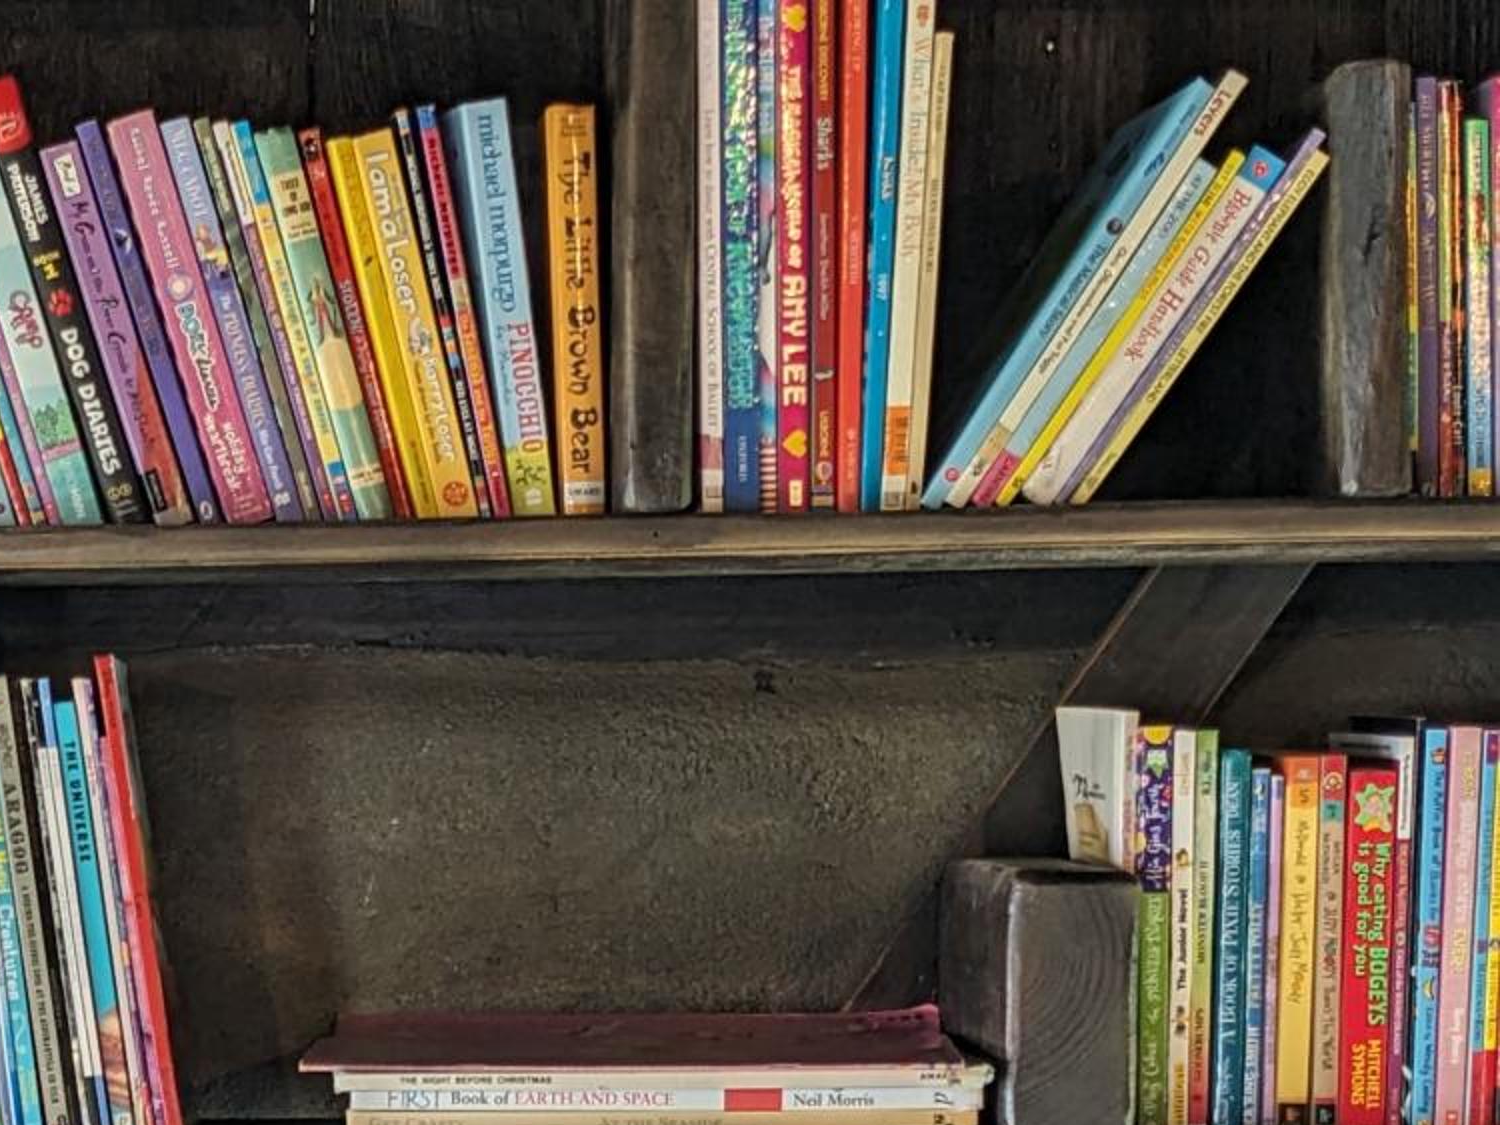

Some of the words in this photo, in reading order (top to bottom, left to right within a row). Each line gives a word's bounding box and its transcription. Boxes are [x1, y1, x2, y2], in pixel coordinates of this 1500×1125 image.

[1190, 87, 1233, 140] Levers
[365, 152, 390, 164] I
[478, 113, 508, 202] michael
[815, 116, 834, 171] Sharks
[7, 162, 41, 243] PATTERSON
[24, 175, 48, 226] JAMES
[370, 166, 392, 214] am
[380, 216, 398, 238] a
[384, 239, 417, 314] Loser
[488, 203, 516, 314] morpurgo
[705, 244, 719, 302] CENTRAL
[7, 290, 44, 350] CAMP
[706, 306, 719, 356] SCHOOL
[781, 274, 807, 338] AMY
[568, 305, 596, 396] Brown
[782, 343, 807, 407] LEE
[59, 327, 90, 380] DOG
[77, 383, 122, 476] DIARIES
[508, 322, 545, 454] PINOCCHIO
[706, 383, 719, 427] BALLET
[434, 402, 455, 464] Loser
[570, 407, 599, 474] Bear
[64, 740, 78, 771] THE
[69, 775, 92, 863] UNIVERSE
[1224, 828, 1241, 897] STORIES
[1357, 840, 1372, 858] is
[1370, 840, 1391, 879] Why
[1178, 888, 1189, 923] Novel
[1351, 860, 1372, 906] good
[1223, 903, 1239, 946] PIXIE
[1354, 909, 1371, 939] for
[1367, 884, 1388, 942] eating
[1176, 926, 1188, 964] Junior
[1224, 953, 1238, 972] OF
[1351, 943, 1368, 976] you
[1176, 967, 1186, 990] The
[1221, 976, 1237, 1022] BOOK
[1366, 946, 1388, 1027] BOGEYS
[1220, 1026, 1236, 1043] A
[450, 1091, 482, 1107] Book
[486, 1090, 510, 1107] of
[514, 1091, 576, 1107] EARTH
[580, 1091, 619, 1107] AND
[623, 1091, 675, 1107] SPACE
[793, 1092, 824, 1108] Neil
[828, 1092, 875, 1108] Morris
[1348, 1043, 1366, 1106] SYMONS
[1364, 1038, 1382, 1110] MITCHELL
